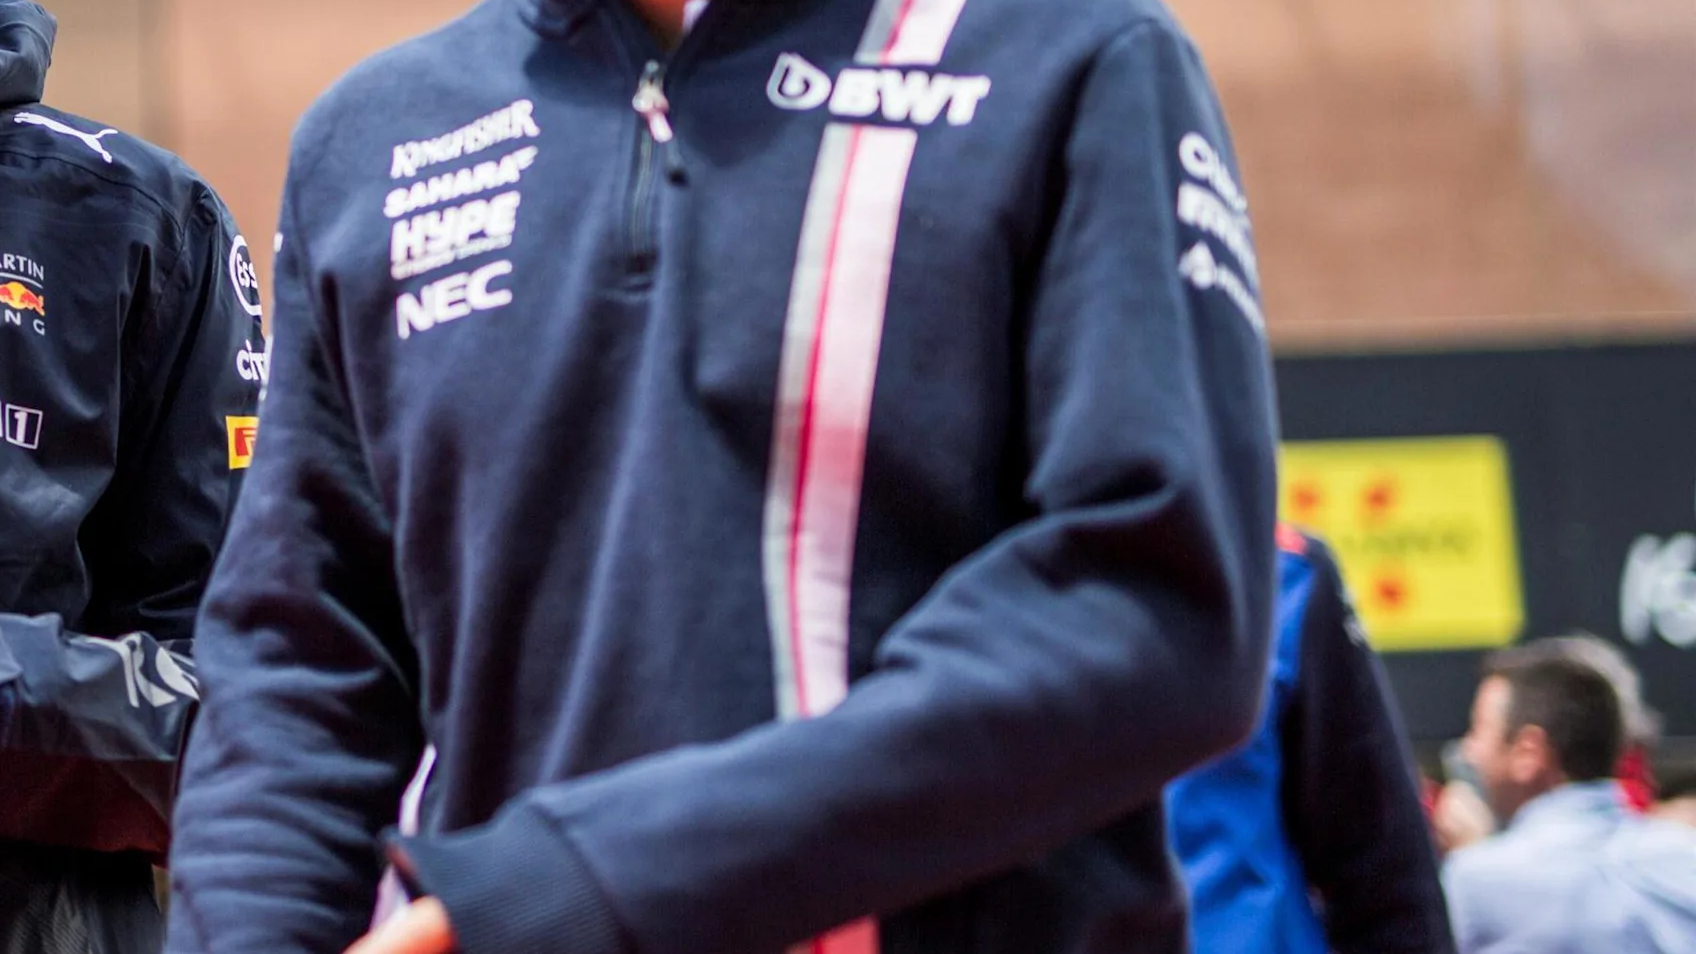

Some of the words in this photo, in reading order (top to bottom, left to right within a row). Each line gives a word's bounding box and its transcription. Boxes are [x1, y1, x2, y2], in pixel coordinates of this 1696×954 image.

[828, 68, 992, 126] BWT
[390, 190, 521, 264] HYPE
[396, 259, 513, 339] NEC
